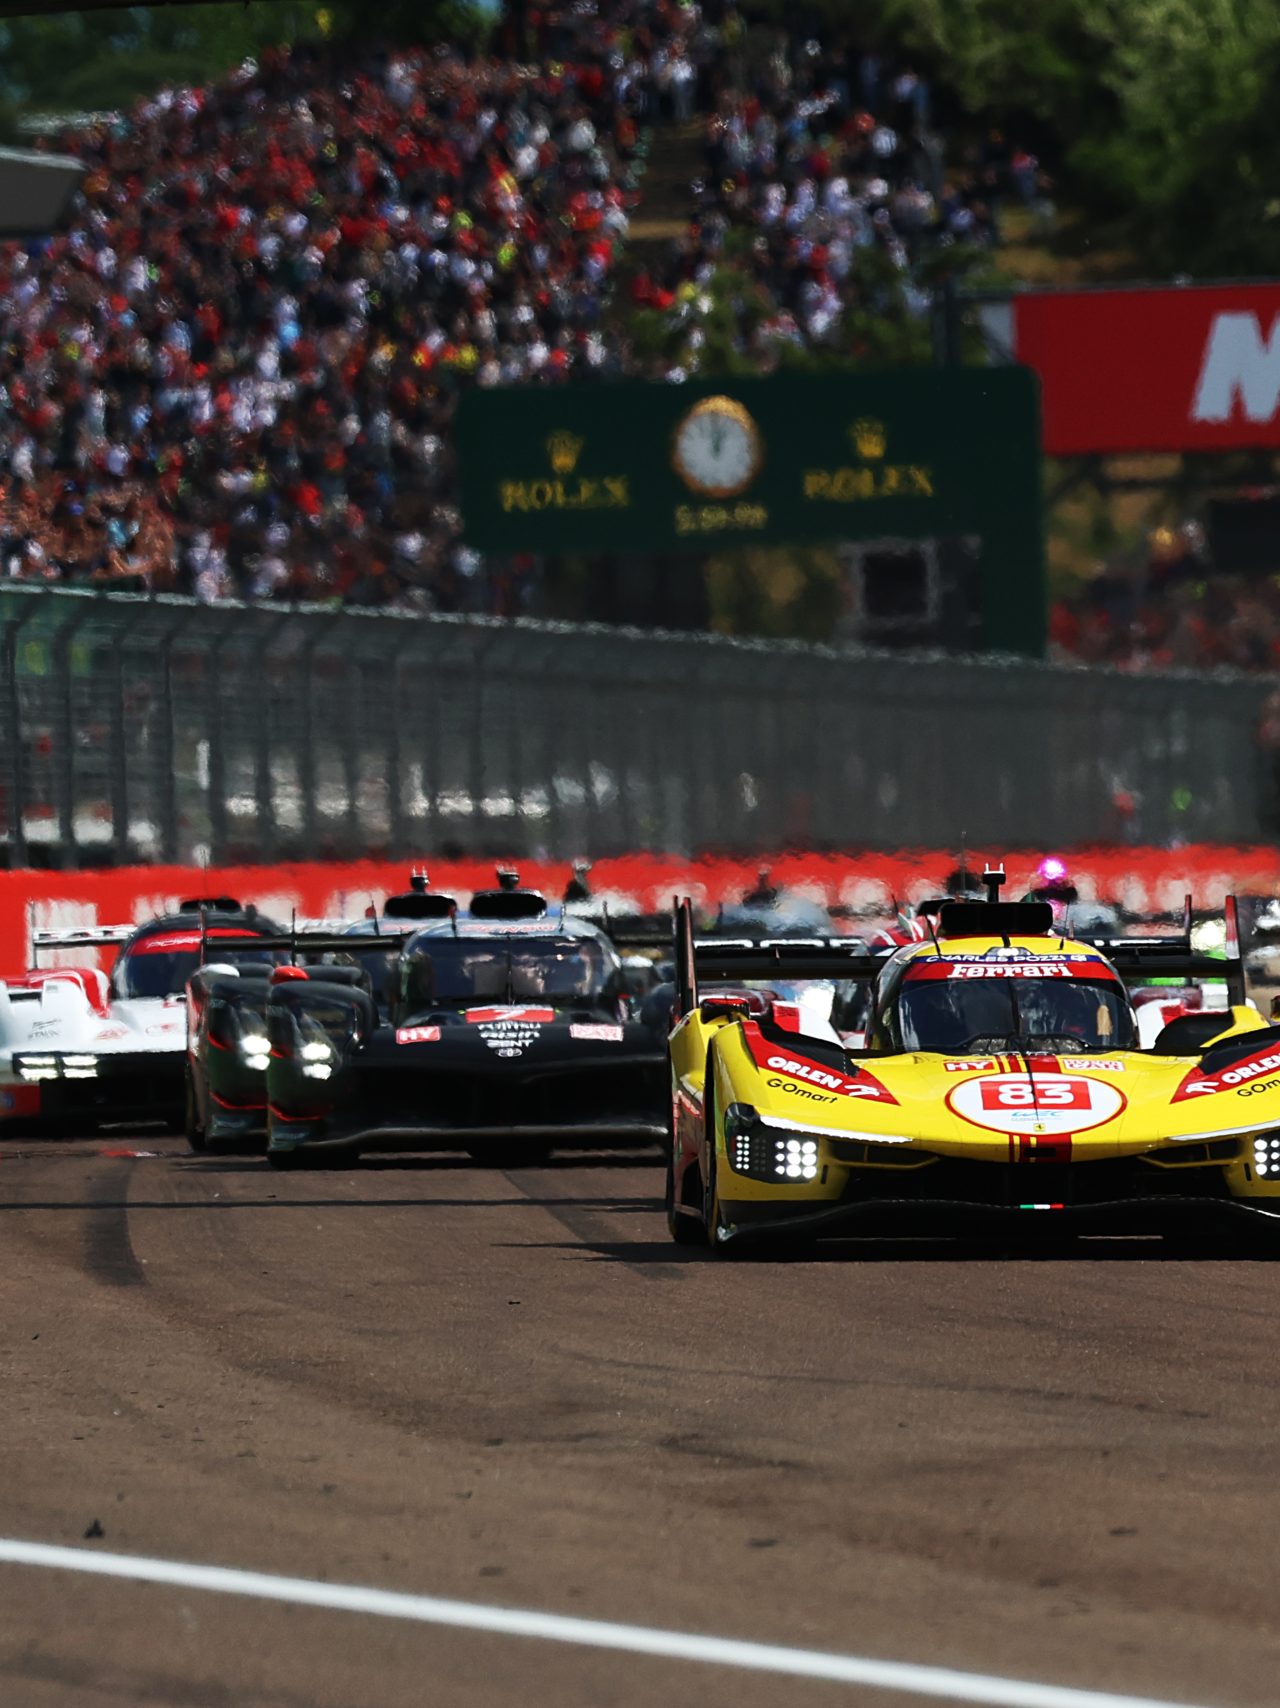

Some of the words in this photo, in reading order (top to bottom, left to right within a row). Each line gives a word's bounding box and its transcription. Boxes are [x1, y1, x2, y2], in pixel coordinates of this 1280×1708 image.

[500, 475, 629, 513] ROLEX
[801, 465, 934, 499] ROLEX
[926, 955, 1008, 963] CHARLES
[947, 963, 1073, 978] Ferrari
[767, 1056, 843, 1089] ORLEN
[945, 1061, 991, 1071] HY
[767, 1078, 838, 1104] GOmart
[998, 1083, 1075, 1105] 83
